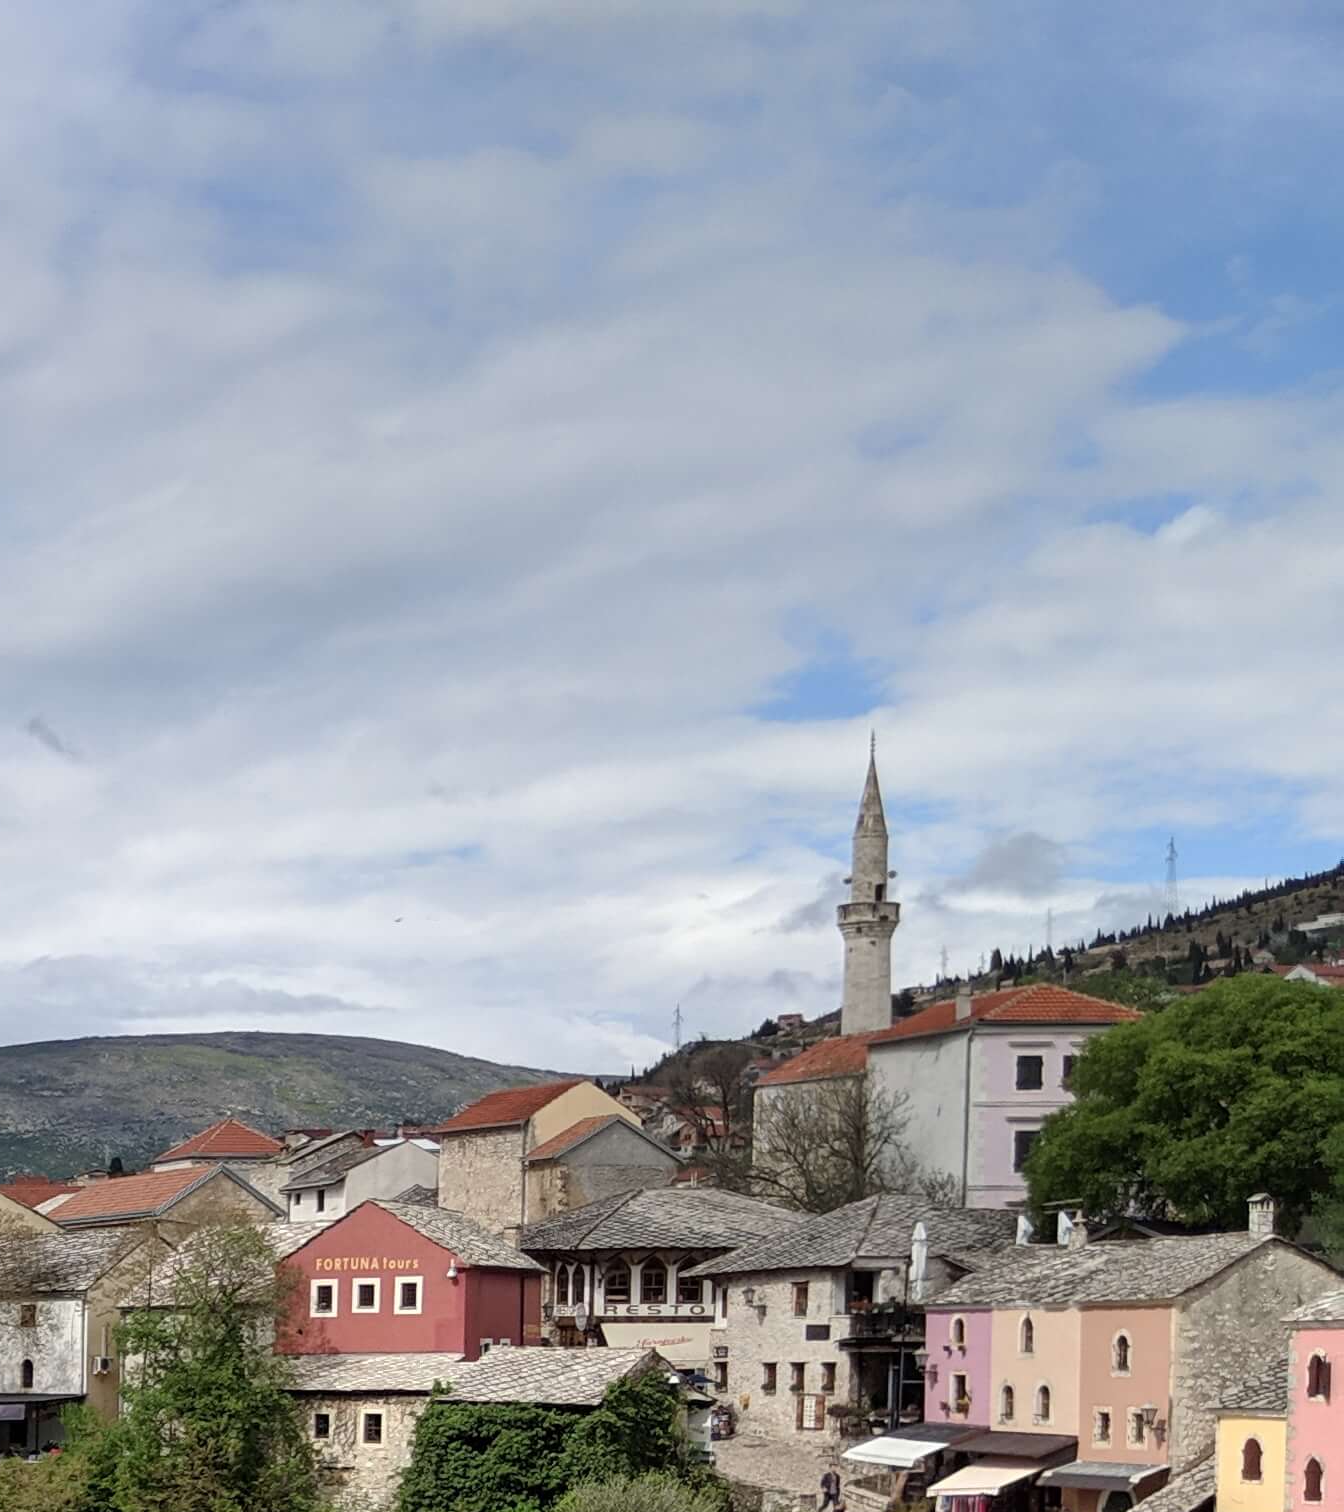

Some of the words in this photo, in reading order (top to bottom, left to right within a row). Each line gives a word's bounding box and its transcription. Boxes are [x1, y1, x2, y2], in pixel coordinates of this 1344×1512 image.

[315, 1257, 379, 1271] FORTUNA
[382, 1257, 419, 1270] tours
[603, 1304, 706, 1316] RESTO
